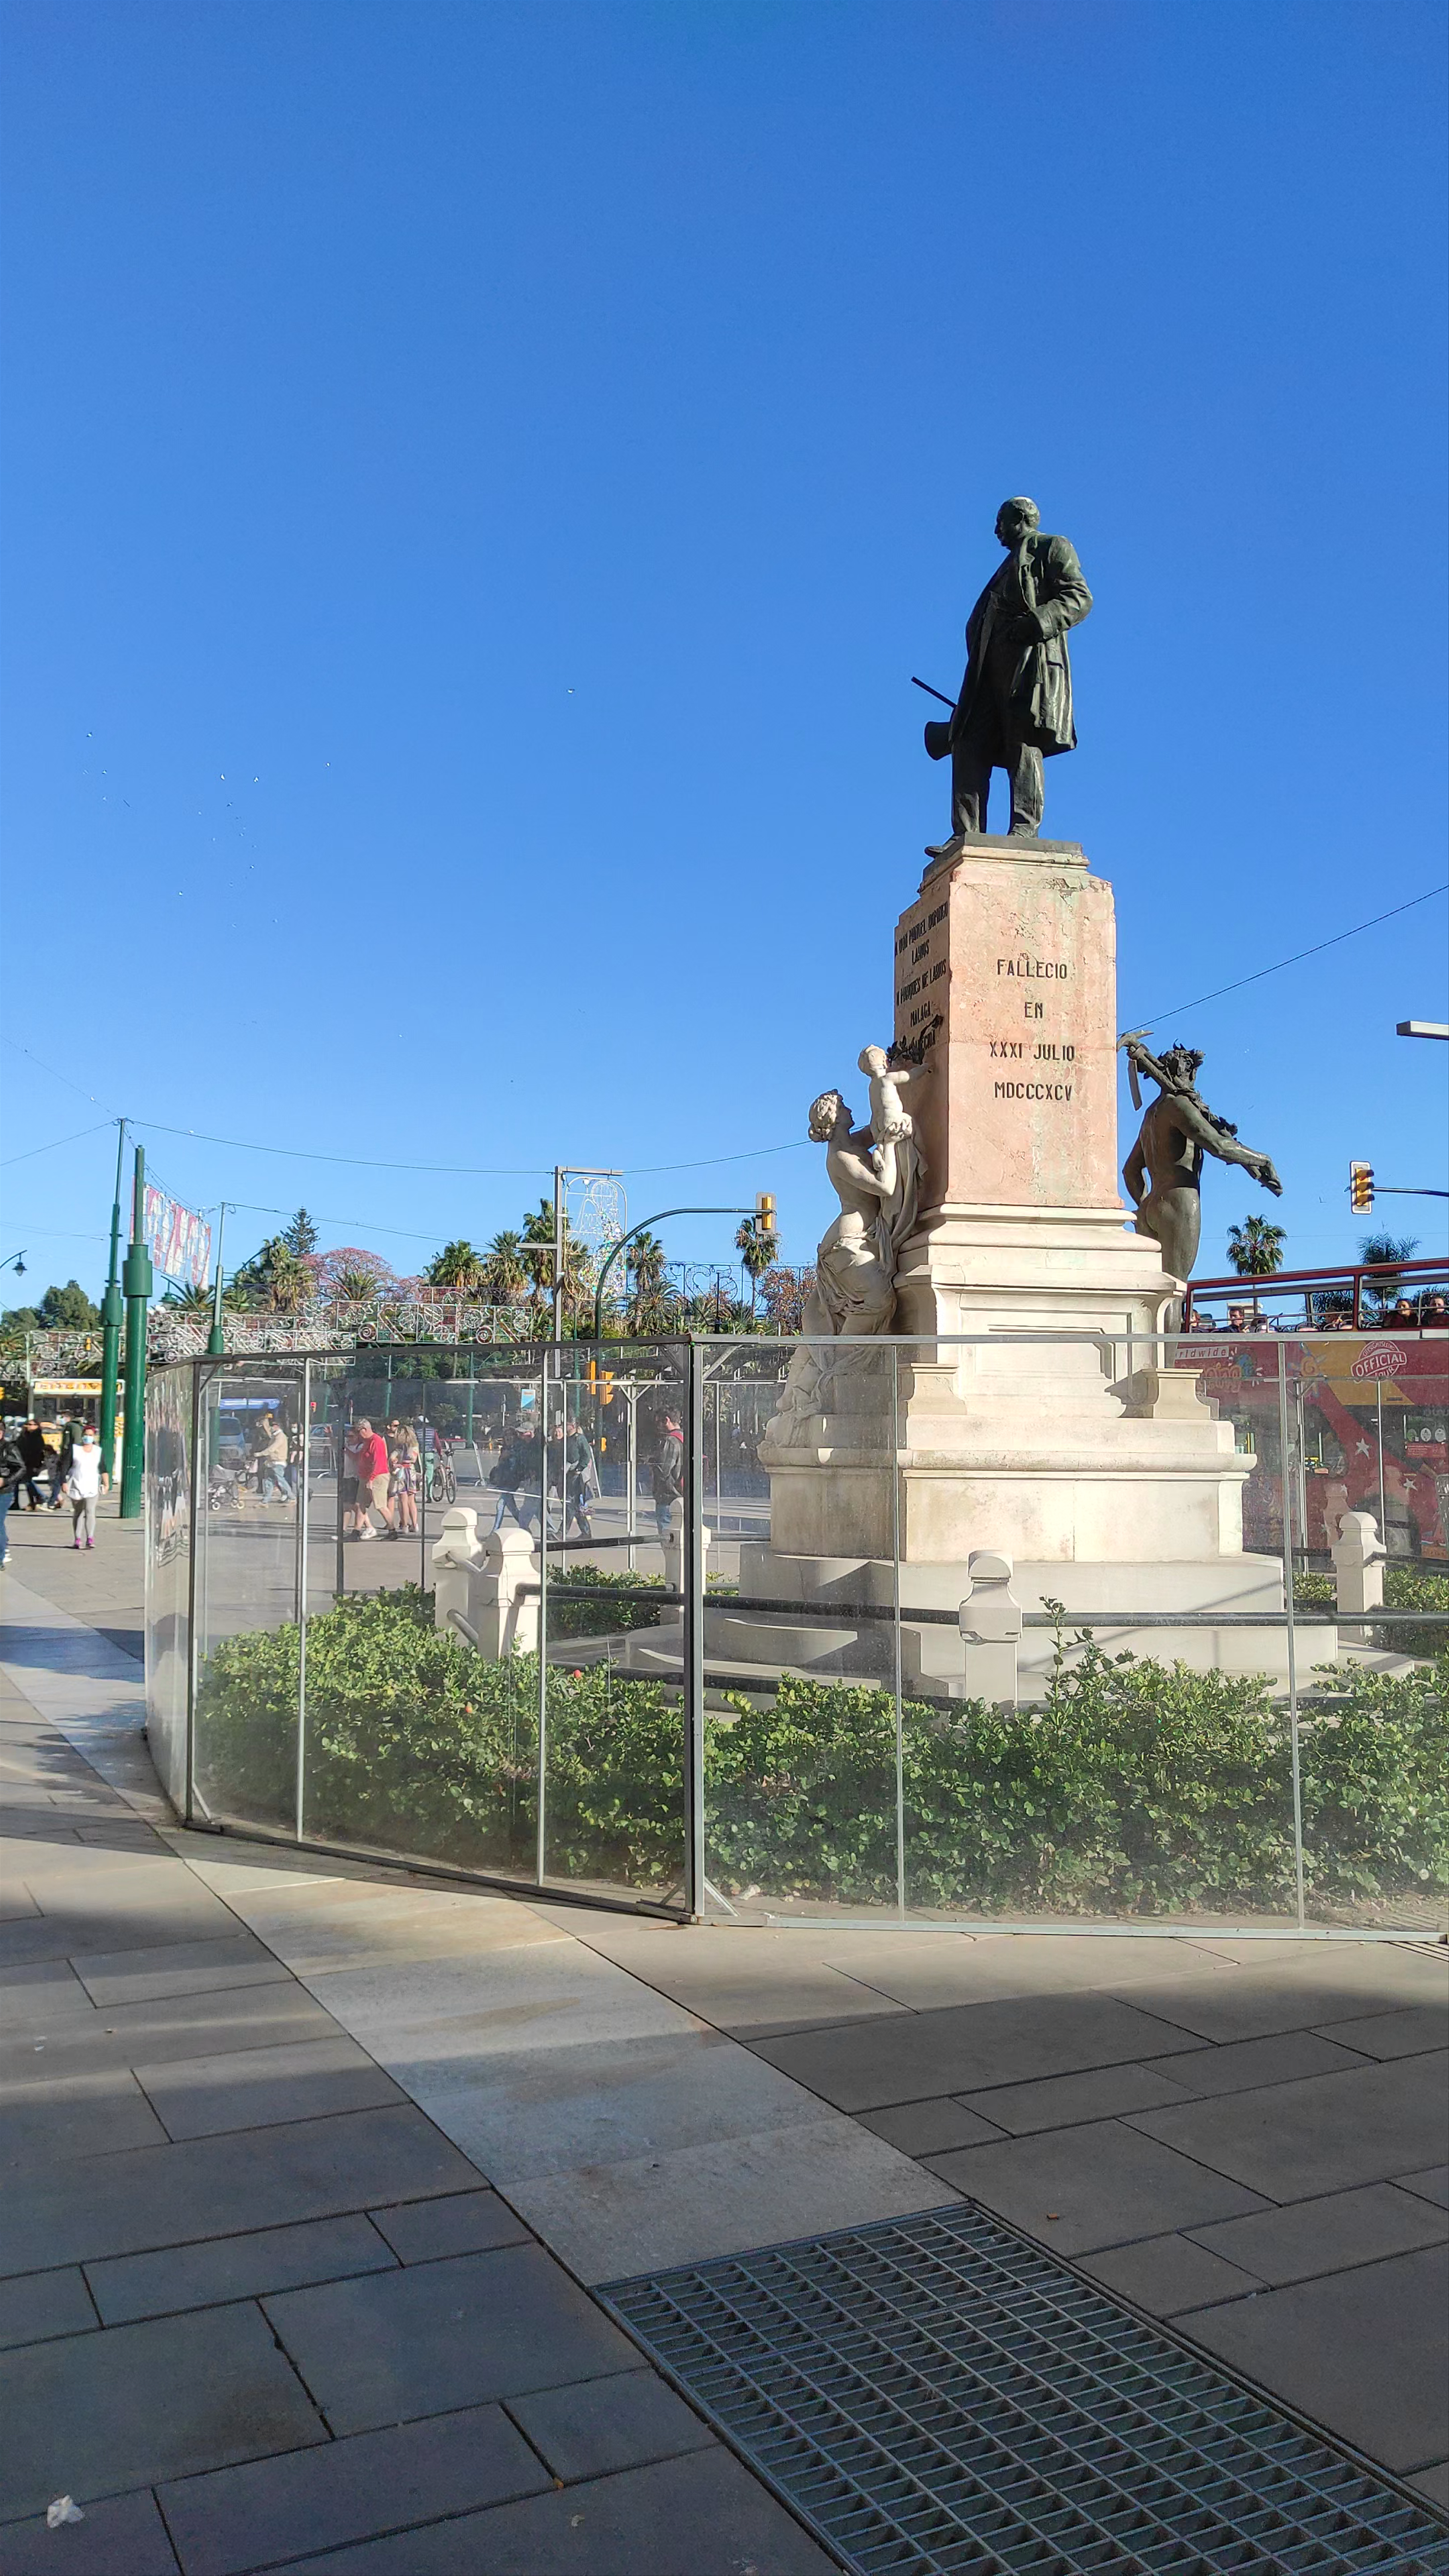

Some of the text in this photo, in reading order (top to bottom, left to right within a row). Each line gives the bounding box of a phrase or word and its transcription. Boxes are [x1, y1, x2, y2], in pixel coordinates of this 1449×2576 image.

[912, 939, 929, 965] LARIOS
[922, 971, 928, 989] DE
[930, 959, 946, 984] LARIOS
[997, 959, 1067, 979] FALLECIO
[1024, 1002, 1043, 1018] EN
[989, 1041, 1075, 1061] XXXI JULIO
[994, 1081, 1072, 1101] MDCCCXCV
[1175, 1347, 1227, 1358] rldwide
[1356, 1353, 1405, 1377] OFFICIAL
